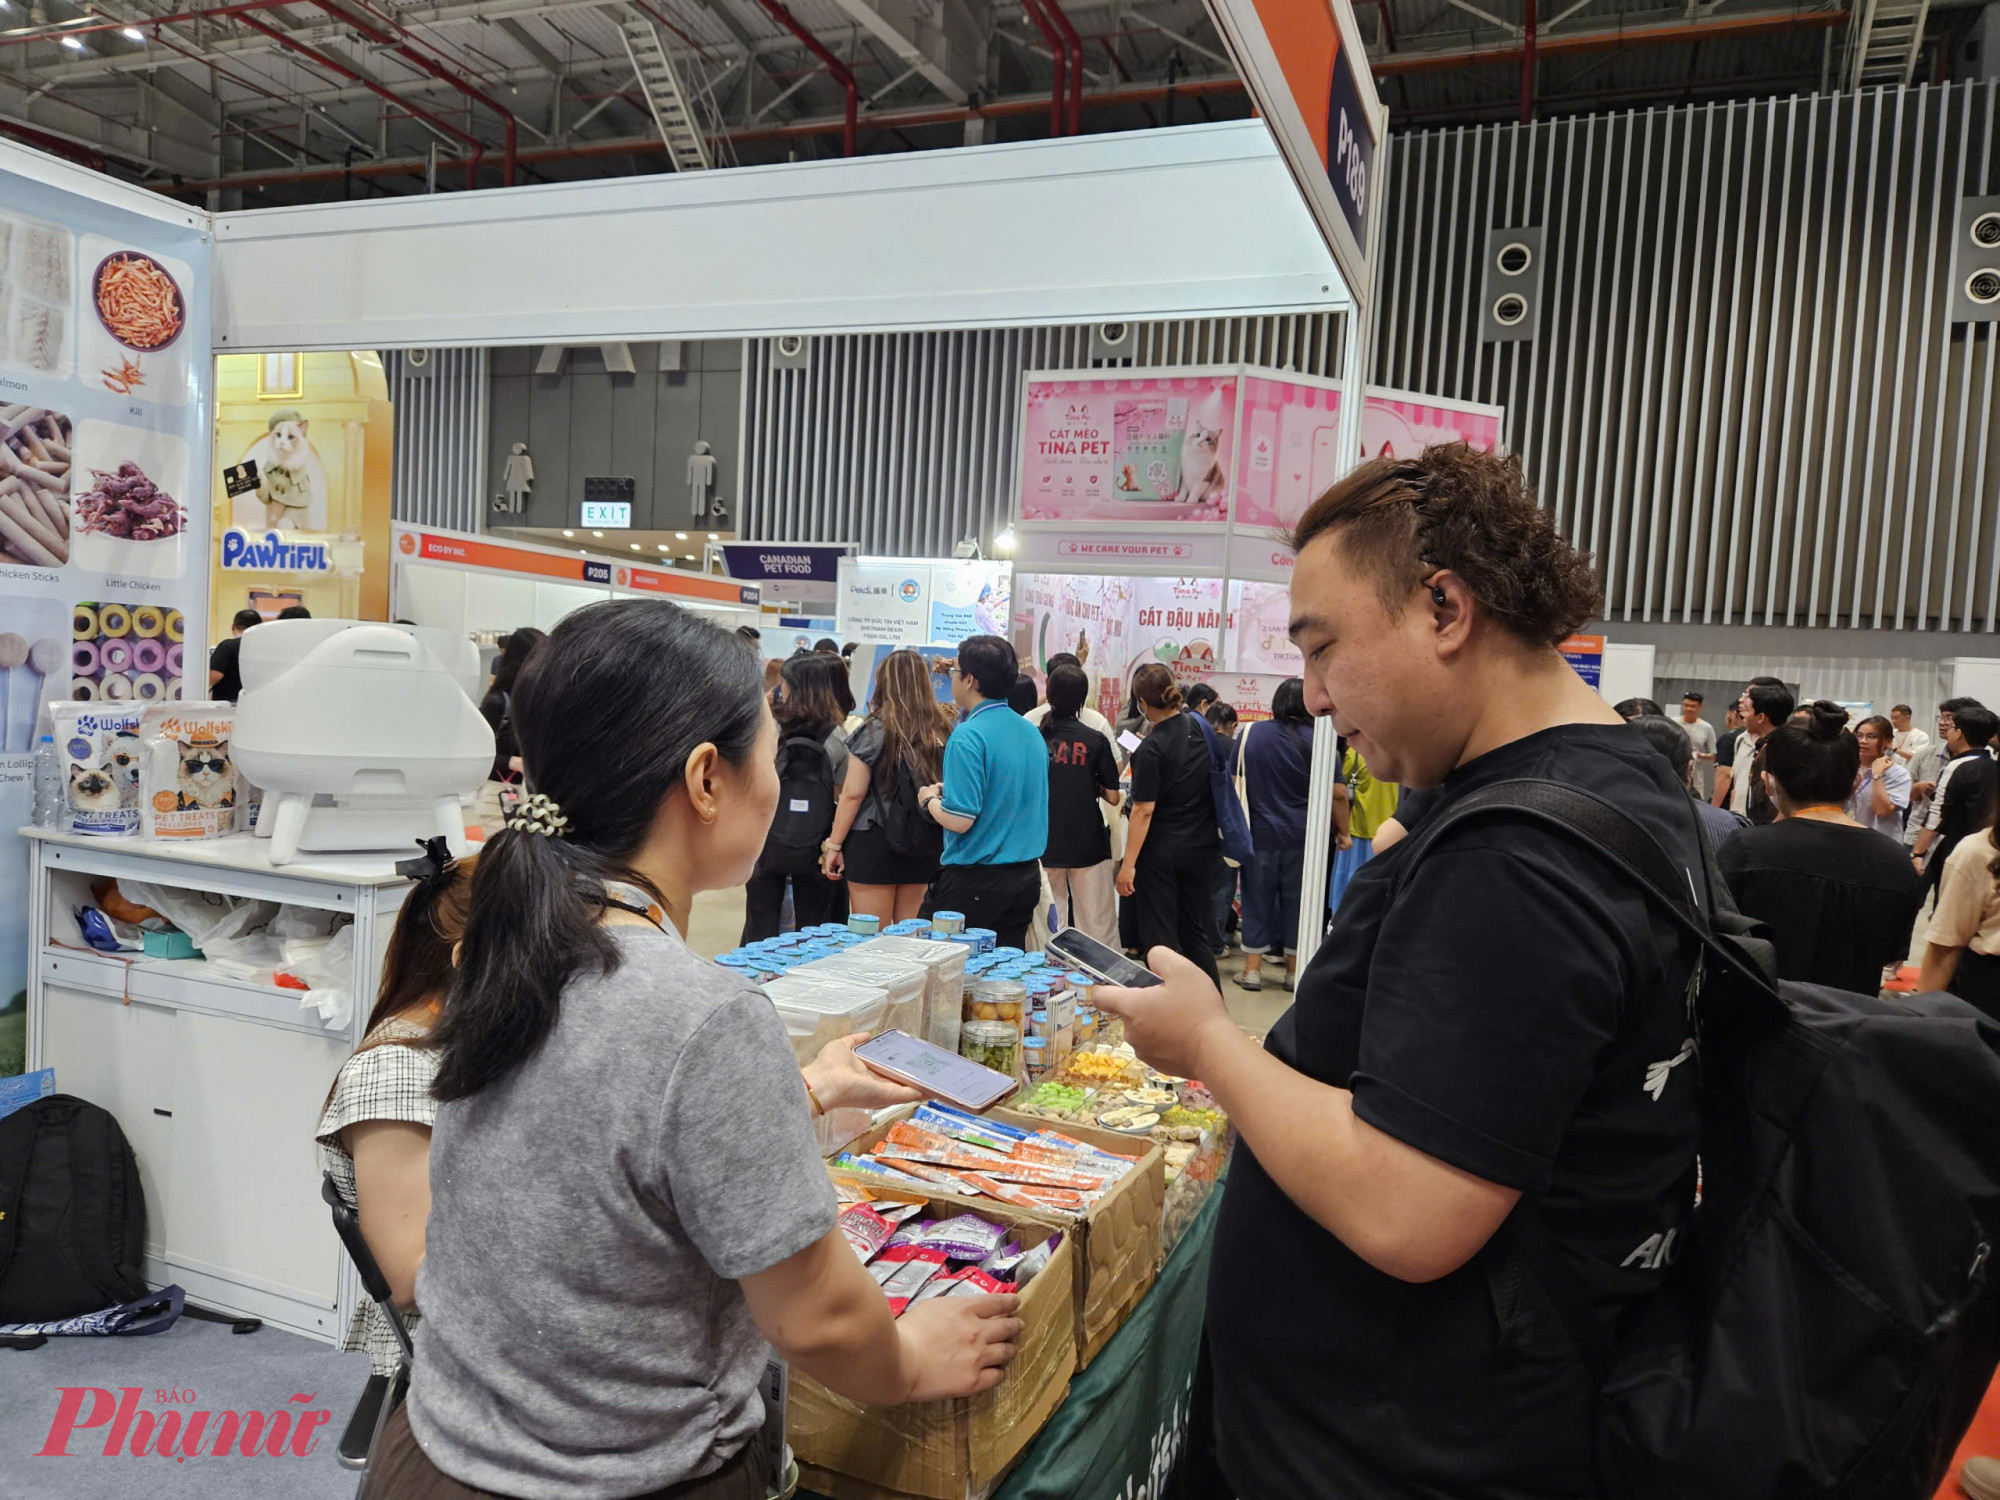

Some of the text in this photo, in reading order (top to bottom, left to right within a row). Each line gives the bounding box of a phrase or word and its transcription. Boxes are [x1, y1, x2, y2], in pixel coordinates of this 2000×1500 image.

[1337, 107, 1365, 216] P189
[1039, 441, 1110, 454] TINA PET
[588, 506, 627, 519] EXIT
[428, 543, 442, 553] ECO
[443, 545, 452, 554] BY
[1081, 544, 1168, 554] WE CARE YOUR PET
[760, 554, 812, 564] CANADIAN
[587, 566, 609, 580] P205
[764, 564, 812, 574] PET FOOD
[32, 571, 60, 583] Sticks
[106, 578, 161, 591] Little Chicken
[743, 590, 758, 600] P204
[1139, 605, 1163, 627] CÁT
[1167, 607, 1193, 631] ĐẬU
[1171, 660, 1201, 673] Tina
[100, 809, 139, 819] TREATS
[155, 812, 216, 822] PET TREATS
